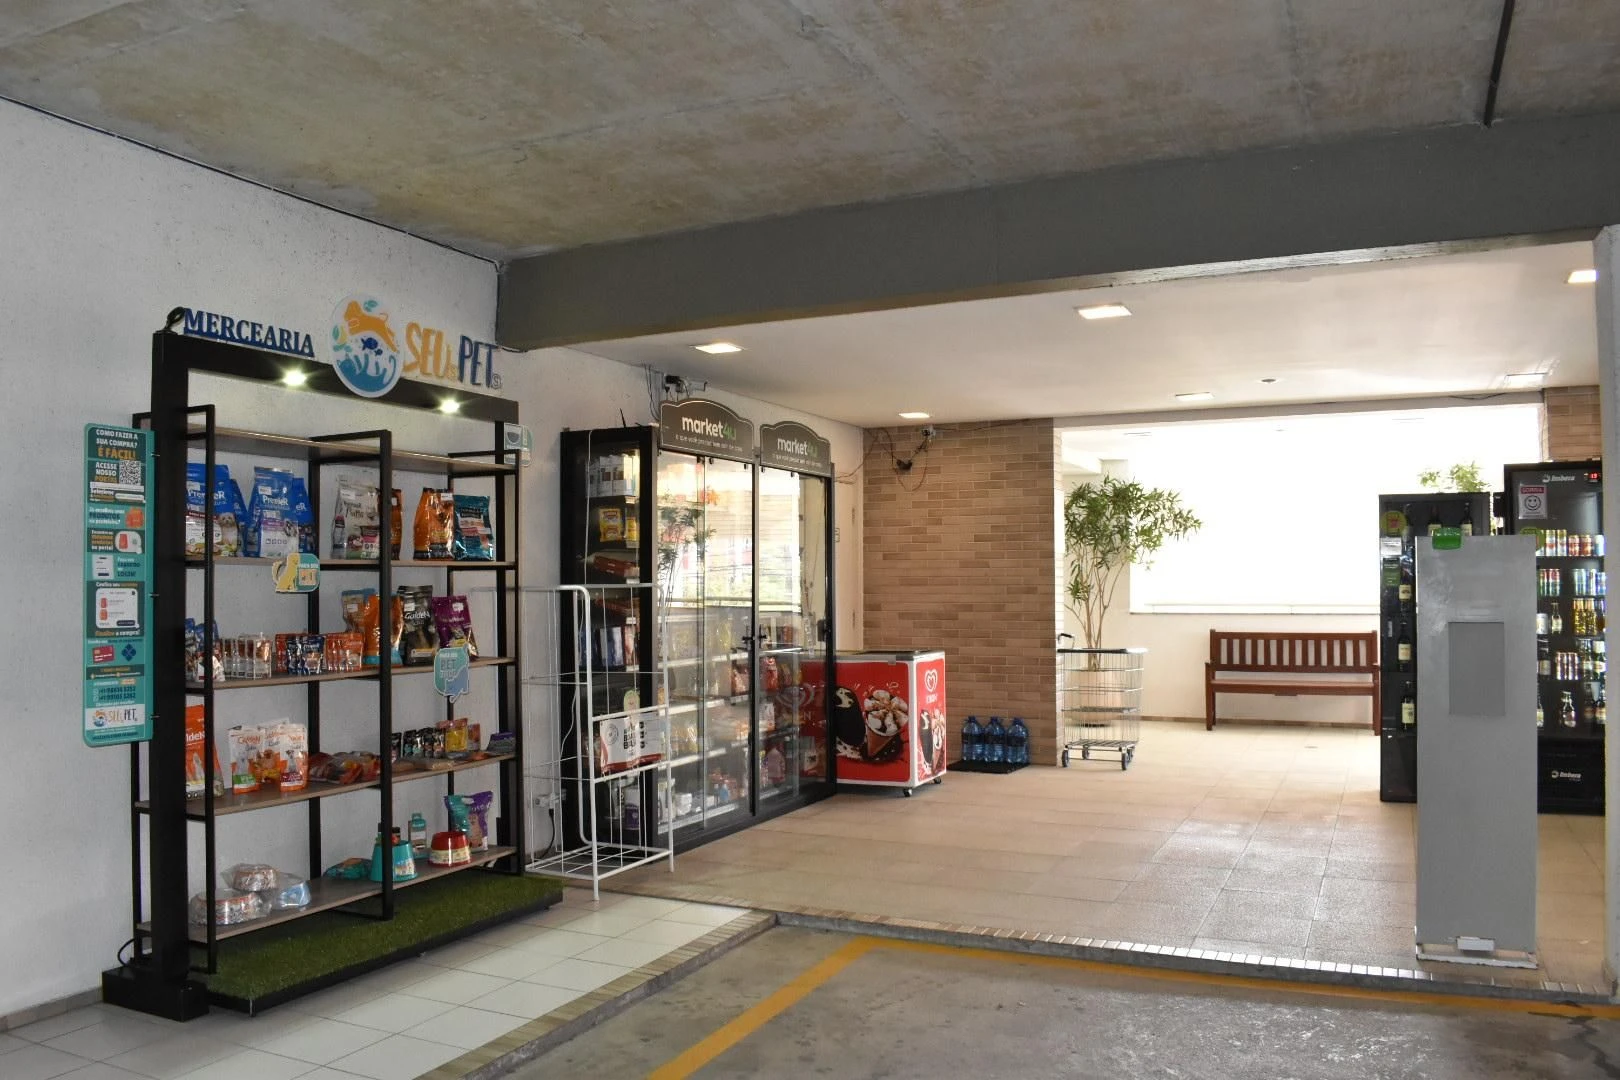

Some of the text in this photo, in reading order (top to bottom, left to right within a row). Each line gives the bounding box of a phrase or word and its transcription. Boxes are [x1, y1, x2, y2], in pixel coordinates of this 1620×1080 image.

[183, 307, 315, 357] MERCEARIA
[96, 429, 114, 437] COMO
[115, 431, 133, 440] FAZER
[109, 440, 138, 448] COMPRA?
[96, 462, 117, 470] ACESSE
[96, 469, 117, 477] NOSSO
